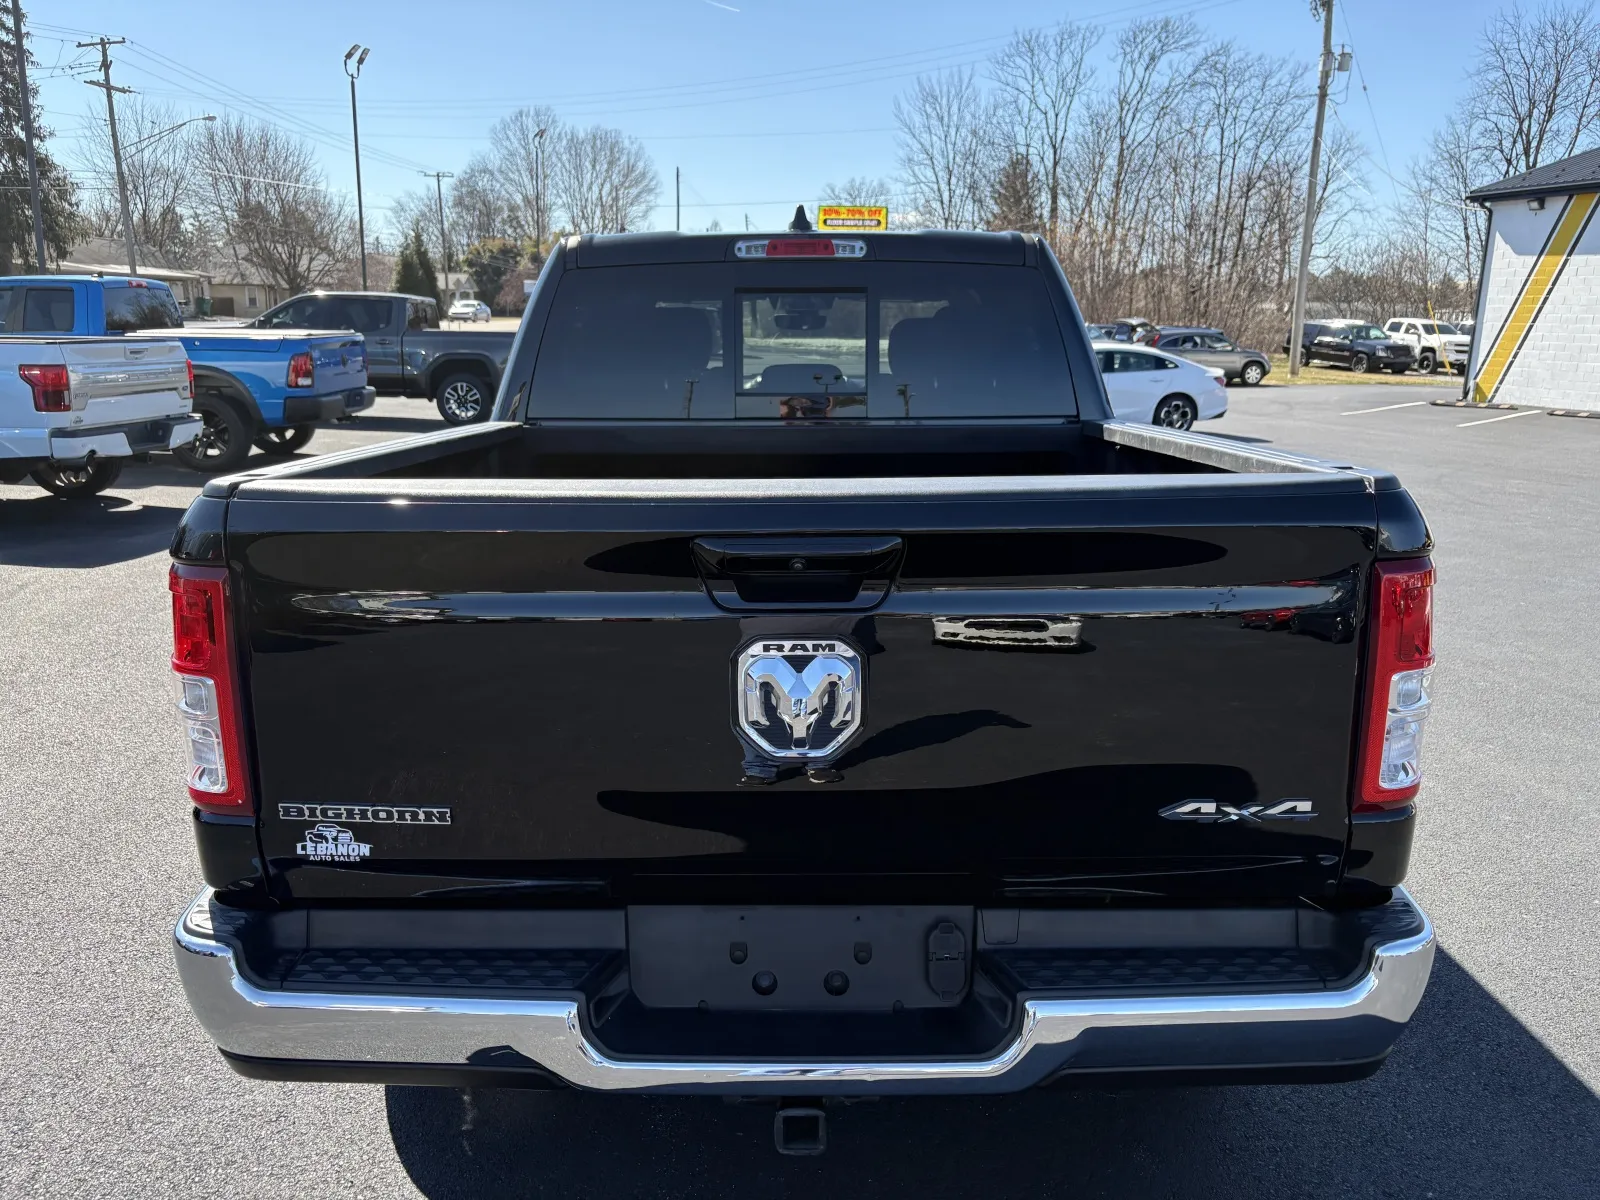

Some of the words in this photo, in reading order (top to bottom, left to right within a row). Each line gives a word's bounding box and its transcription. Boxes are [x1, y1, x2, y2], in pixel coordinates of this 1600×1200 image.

[762, 643, 836, 653] RAM
[278, 803, 451, 825] BIGHORN
[296, 843, 371, 857] LEBANON
